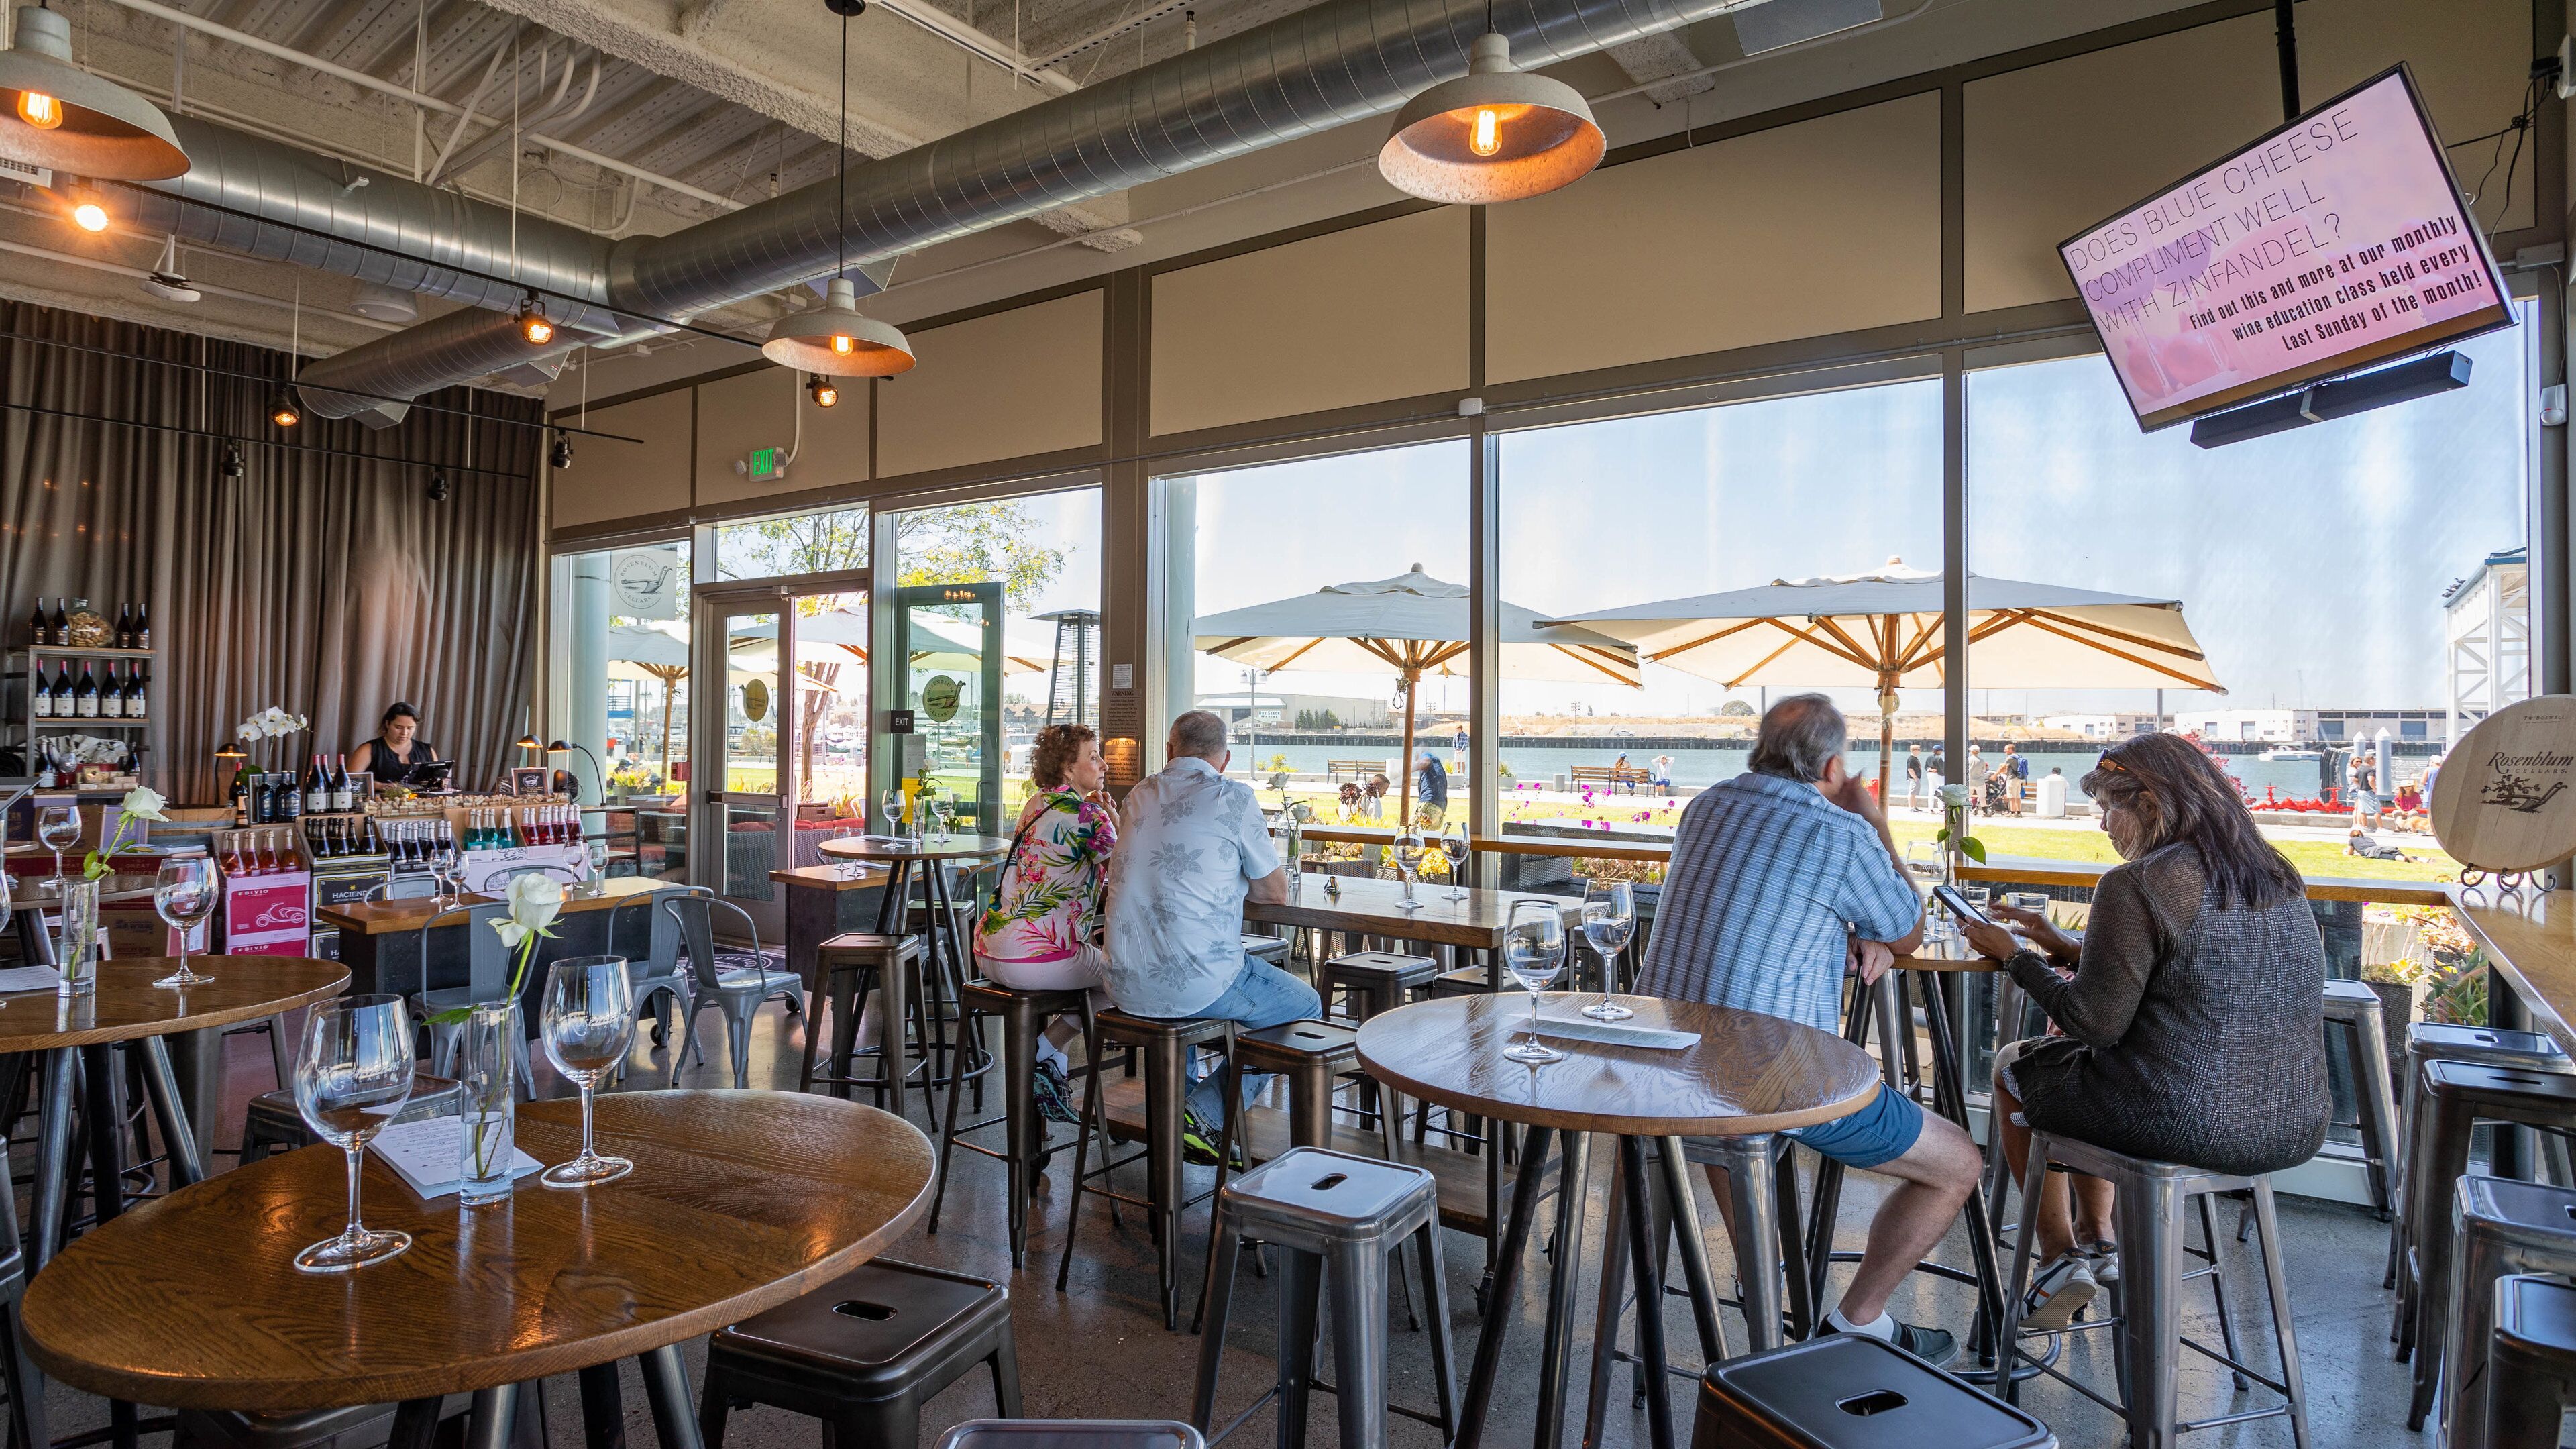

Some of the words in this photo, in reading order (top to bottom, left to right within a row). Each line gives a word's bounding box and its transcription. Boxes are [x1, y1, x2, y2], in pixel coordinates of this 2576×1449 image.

[2070, 223, 2137, 271] DOES
[2143, 182, 2216, 235] BLUE
[2223, 109, 2359, 194] CHEESE
[2086, 216, 2229, 301] COMPLIMENT
[2234, 180, 2325, 233] WELL
[2190, 312, 2216, 330] Find
[2218, 300, 2239, 320] out
[2241, 290, 2267, 310] this
[2270, 277, 2296, 300] and
[2298, 266, 2335, 288] more
[2339, 254, 2353, 273] at
[2359, 243, 2385, 266] our
[2391, 215, 2458, 253] monthly
[2232, 319, 2263, 341] wine
[2265, 294, 2332, 330] education
[2336, 277, 2376, 305] class
[2379, 262, 2416, 288] held
[2419, 244, 2470, 276] every
[2098, 292, 2160, 333] WITH
[2282, 329, 2313, 351] Last
[2316, 311, 2367, 341] Sunday
[2371, 302, 2389, 322] of
[2391, 291, 2418, 313] the
[2422, 269, 2483, 305] month!
[753, 449, 773, 476] EXIT
[620, 561, 657, 577] ROSENBLUM
[624, 591, 651, 603] CELLARS
[895, 718, 908, 726] EXIT
[2486, 751, 2574, 774] Rosenblum
